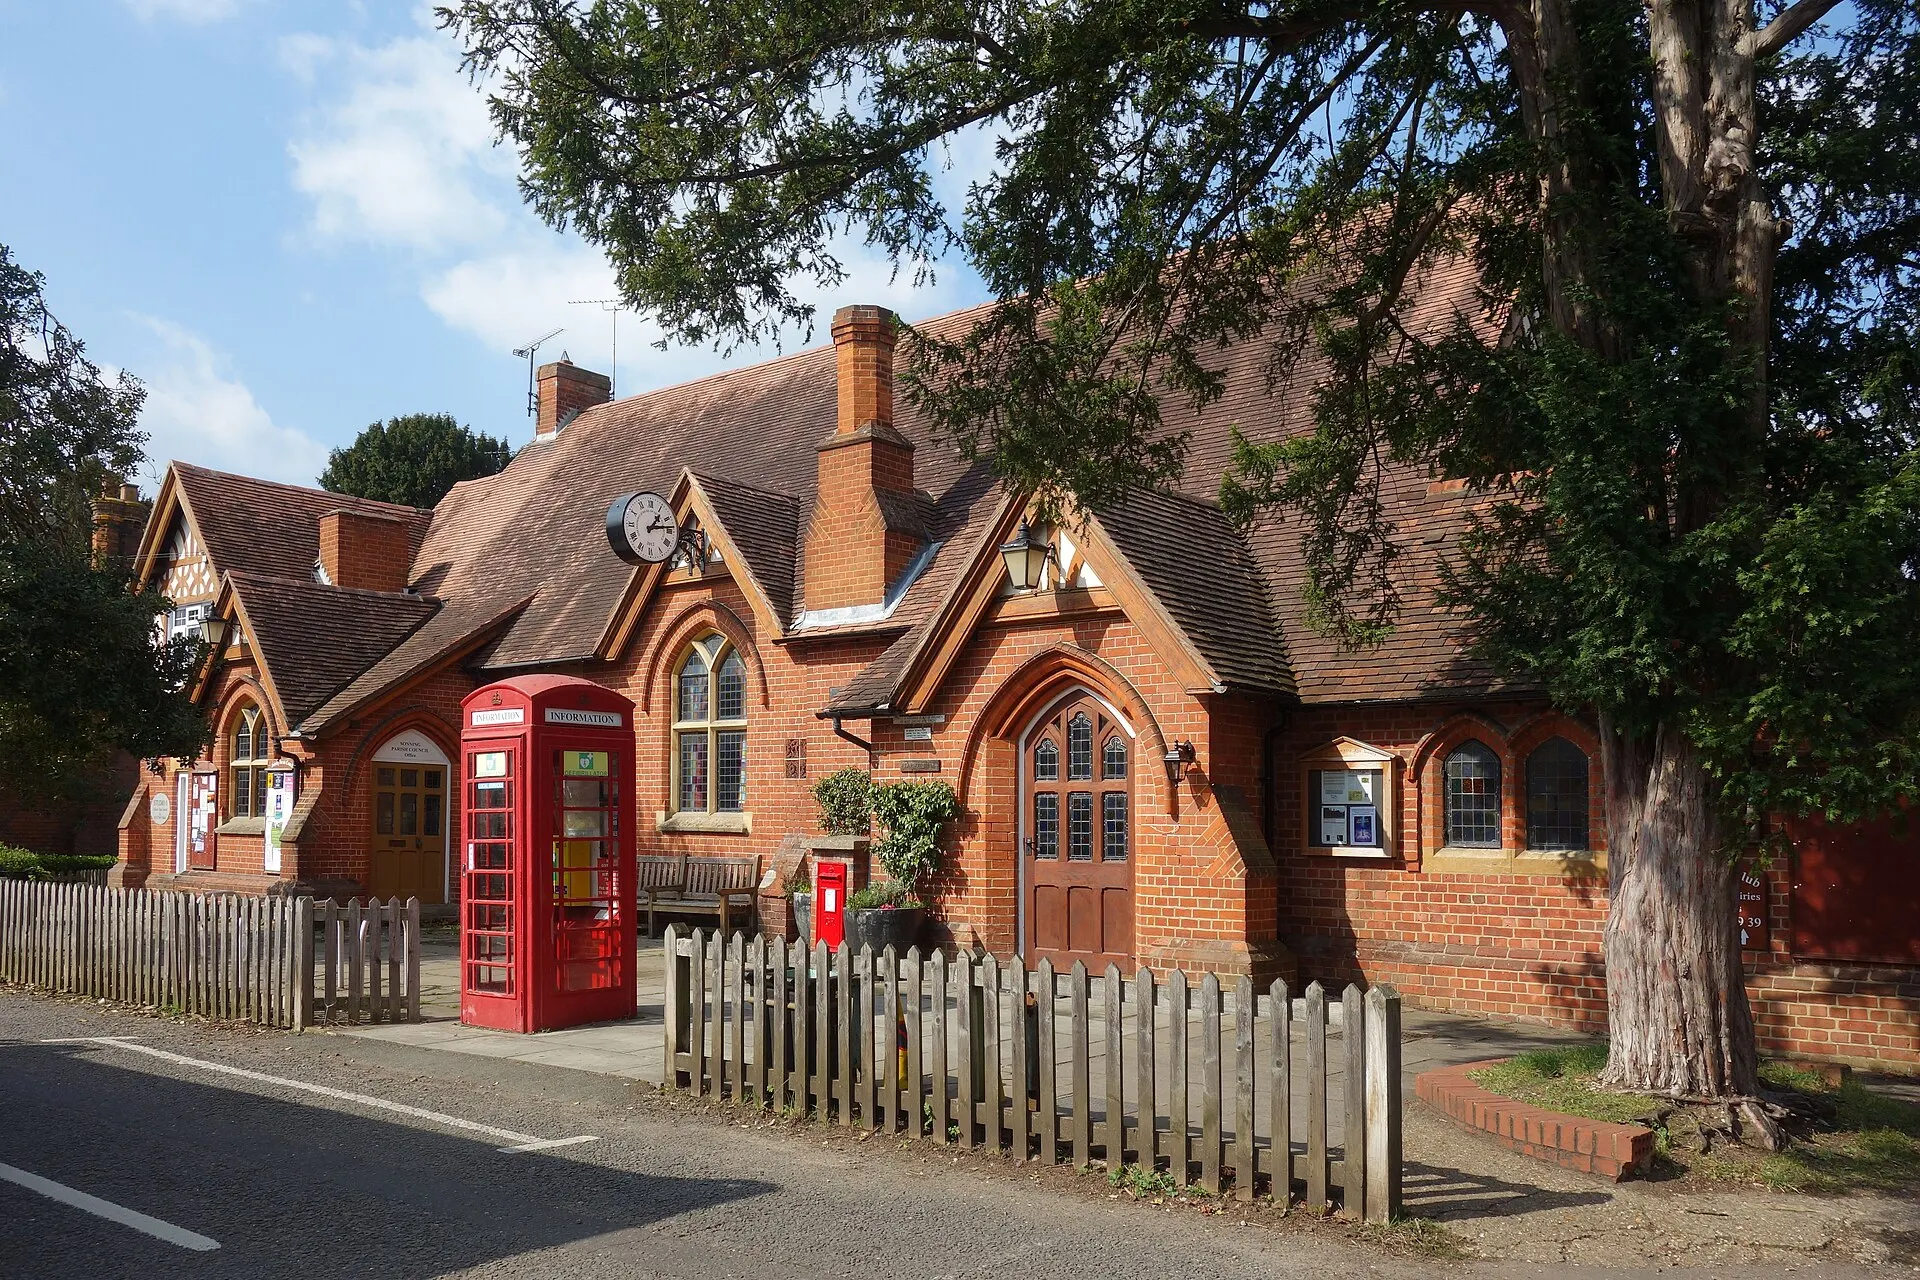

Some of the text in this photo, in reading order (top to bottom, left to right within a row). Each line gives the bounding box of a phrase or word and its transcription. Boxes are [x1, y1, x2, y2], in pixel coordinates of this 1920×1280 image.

[476, 712, 520, 722] INFORMATION
[550, 712, 614, 723] INFORMATION
[1741, 872, 1760, 888] lub
[1740, 892, 1760, 900] iries
[1748, 917, 1761, 927] 39
